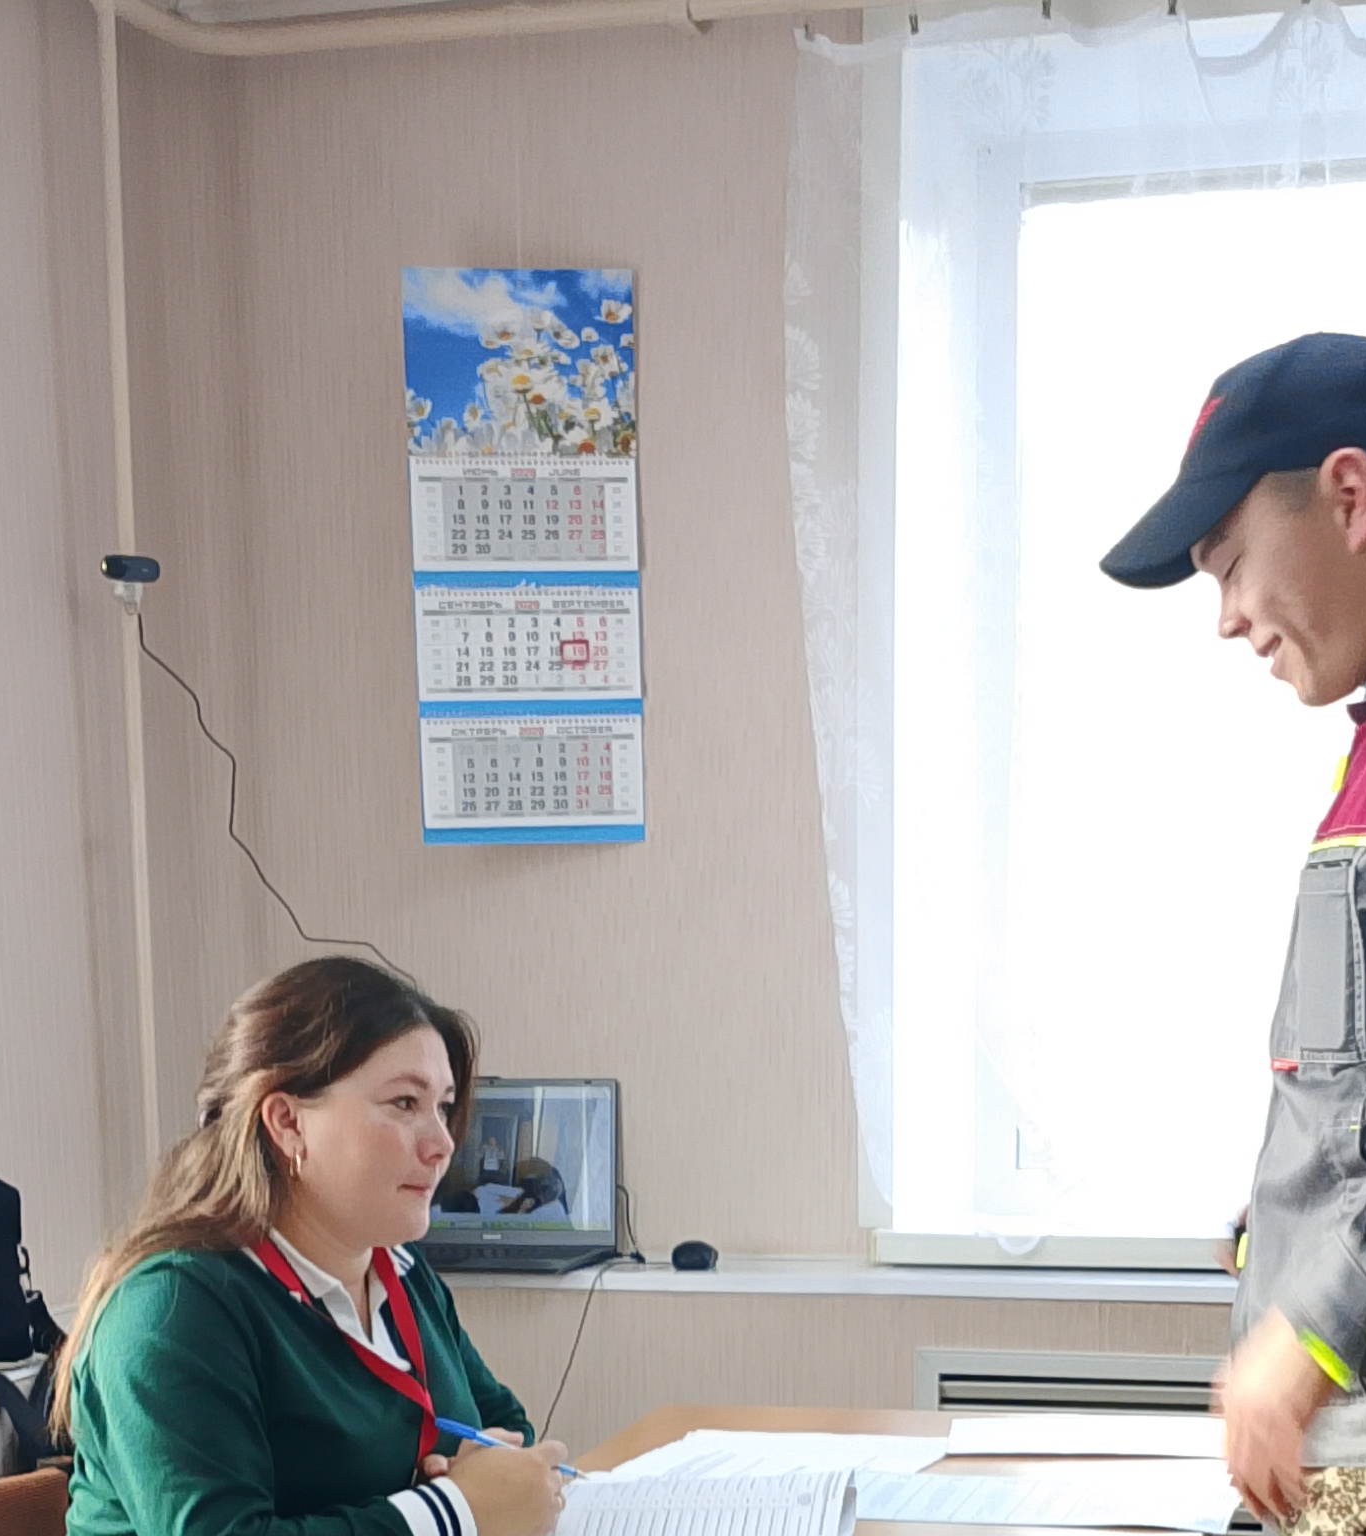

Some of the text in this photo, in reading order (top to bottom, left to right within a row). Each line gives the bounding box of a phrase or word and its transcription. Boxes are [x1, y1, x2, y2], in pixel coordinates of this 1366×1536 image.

[499, 500, 512, 510] 10
[522, 500, 534, 509] 11
[546, 500, 558, 510] 12
[569, 500, 581, 510] 13
[592, 500, 604, 510] 14
[453, 514, 604, 525] 15 16 17 18 19 20 21
[452, 529, 606, 540] 22 23 24 25 26 27 28
[452, 543, 467, 554] 29
[476, 543, 491, 554] 30
[552, 600, 624, 608] SEPTEMBER
[526, 631, 539, 642] 10
[550, 631, 560, 641] 11
[595, 631, 607, 641] 13
[457, 647, 470, 657] 14
[481, 647, 493, 657] 15
[504, 646, 516, 656] 16
[526, 646, 540, 656] 17
[572, 646, 584, 656] 19
[593, 646, 608, 656] 20
[456, 662, 469, 672] 21
[479, 661, 494, 672] 22
[502, 661, 517, 671] 23
[526, 660, 540, 671] 24
[548, 661, 563, 671] 25
[592, 660, 608, 670] 27
[457, 676, 471, 686] 28
[480, 675, 495, 685] 29
[503, 675, 518, 688] 30
[556, 726, 613, 734] OCTOBER
[576, 756, 589, 766] 10
[598, 757, 611, 766] 11
[463, 771, 612, 783] 12 13 14 15 16 17 18
[463, 785, 612, 798] 19 20 21 22 23 24 25
[462, 801, 477, 811] 26
[485, 801, 500, 811] 27
[508, 800, 522, 810] 28
[531, 799, 545, 810] 29
[554, 799, 568, 809] 30
[577, 799, 589, 809] 31
